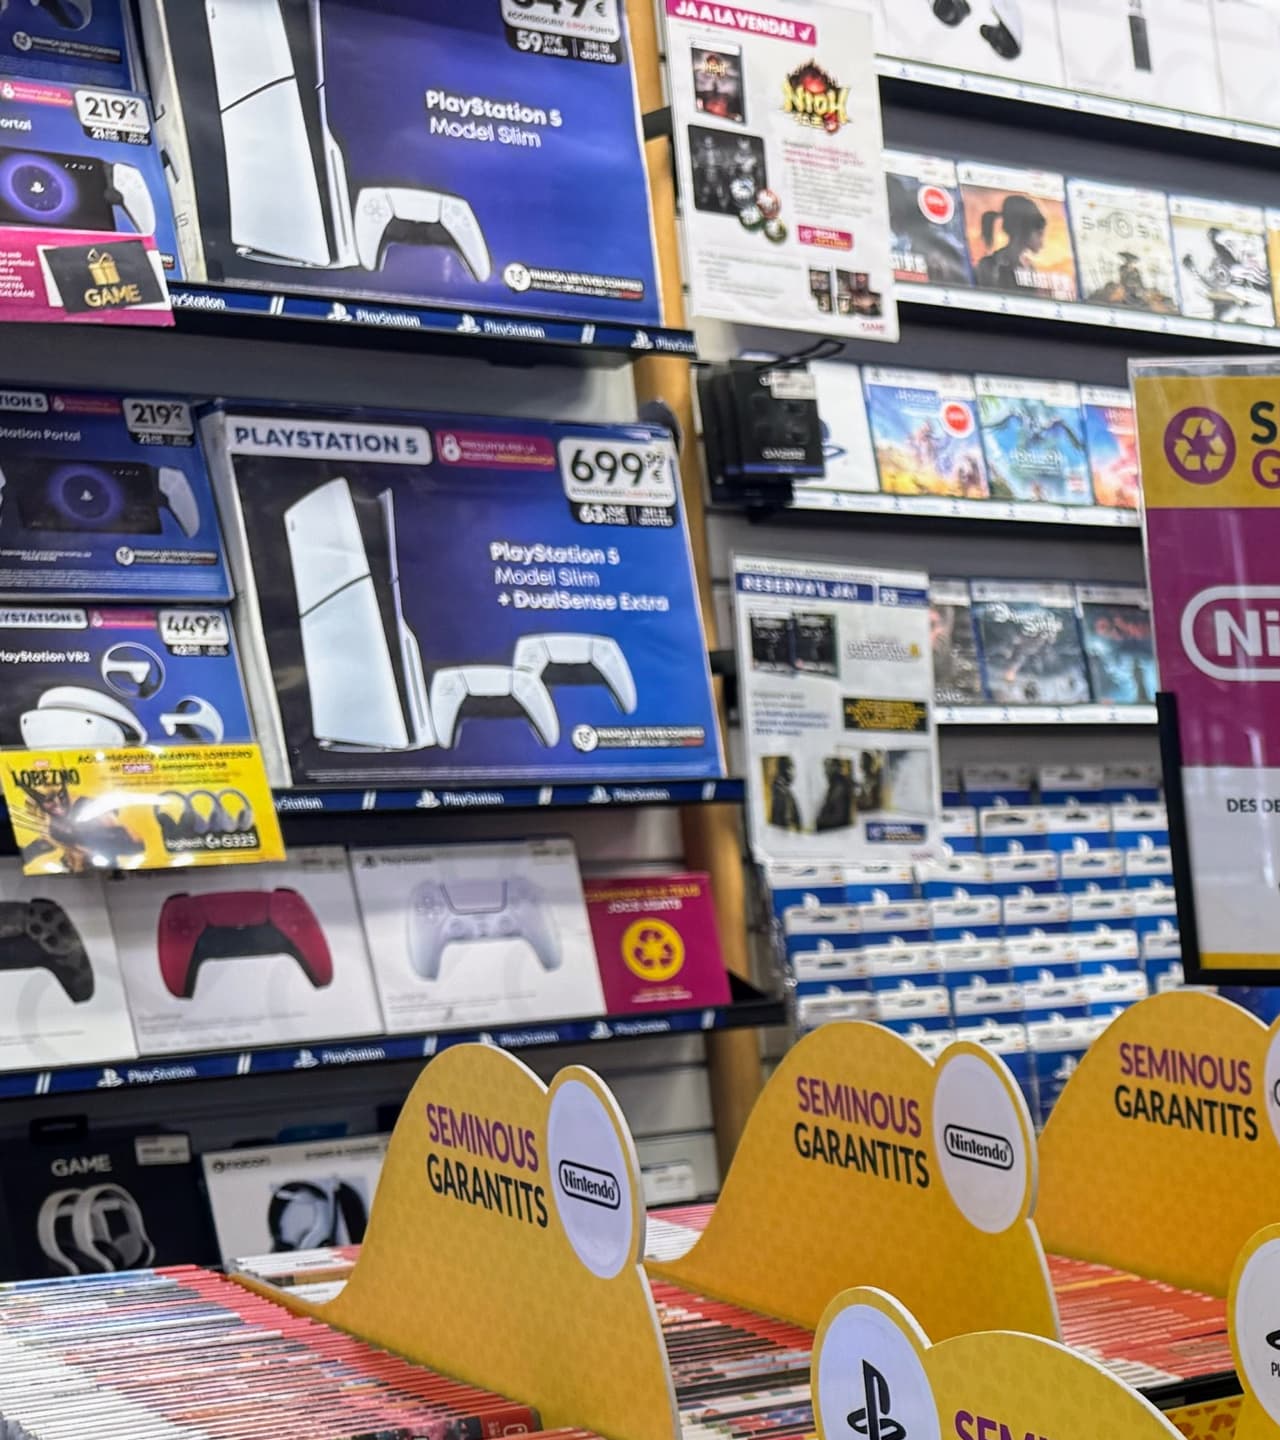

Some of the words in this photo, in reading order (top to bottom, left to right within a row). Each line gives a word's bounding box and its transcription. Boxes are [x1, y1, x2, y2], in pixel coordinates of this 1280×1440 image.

[425, 88, 542, 122] PlayStation
[549, 110, 562, 126] 5
[429, 117, 495, 143] Model
[499, 126, 541, 149] Slim
[84, 284, 141, 308] GAME
[356, 310, 421, 328] PlayStation
[235, 427, 400, 451] PLAYSTATION
[405, 437, 418, 452] 5
[490, 542, 605, 565] PlayStation
[608, 548, 621, 565] 5
[495, 567, 556, 587] Model
[560, 570, 600, 587] Slim
[514, 591, 617, 612] DualSense
[620, 593, 670, 612] Extra
[128, 1064, 196, 1083] PlayStation
[1119, 1042, 1252, 1095] SEMINOUS
[796, 1076, 922, 1137] SEMINOUS
[1114, 1085, 1258, 1142] GARANTITS
[426, 1103, 540, 1172] SEMINOUS
[949, 1132, 1008, 1163] Nintendo
[51, 1155, 112, 1175] GAME
[793, 1122, 930, 1188] GARANTITS
[426, 1155, 549, 1229] GARANTITS
[563, 1168, 620, 1201] Nintendo
